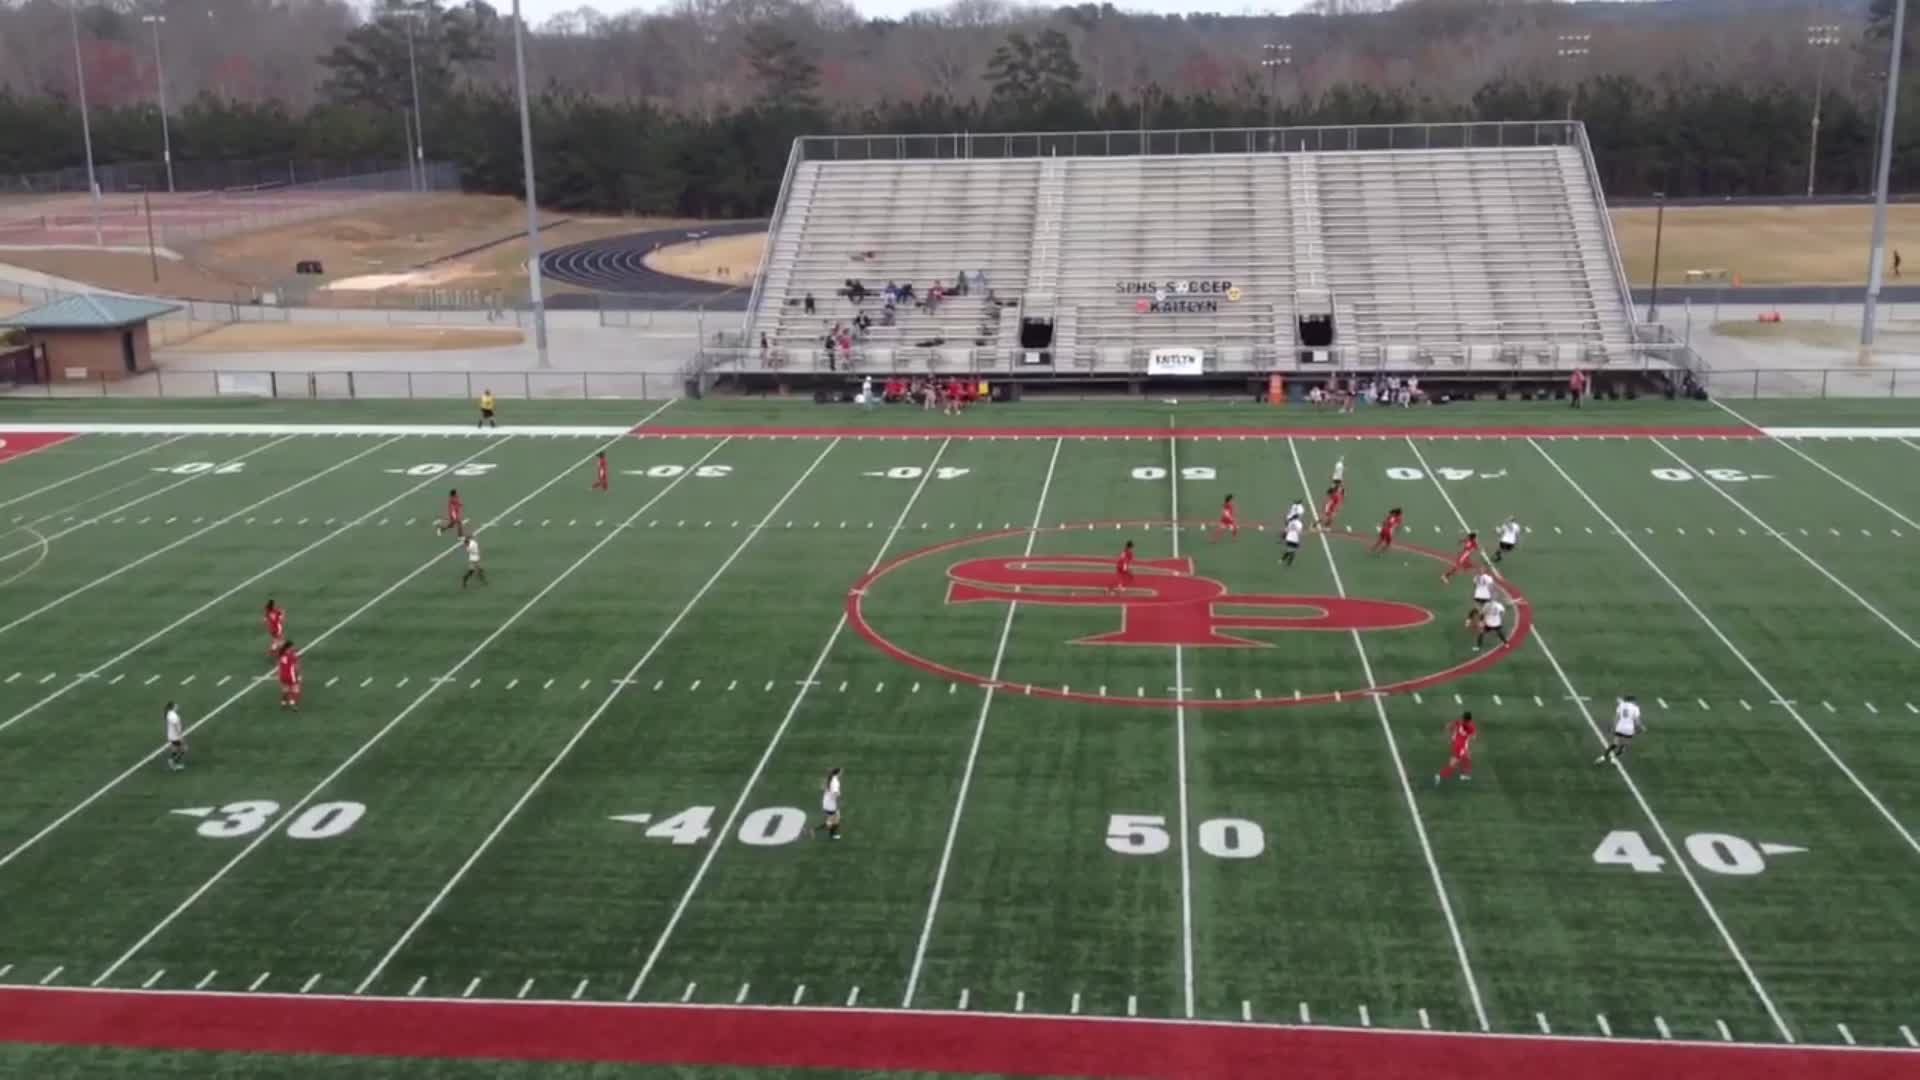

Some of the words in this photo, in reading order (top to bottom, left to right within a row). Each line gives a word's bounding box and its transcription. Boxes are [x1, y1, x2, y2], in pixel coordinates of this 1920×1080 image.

[1116, 281, 1157, 293] SPHS
[1150, 300, 1217, 312] KAITLYN
[196, 801, 366, 838] 30
[645, 806, 807, 845] 40
[1105, 814, 1264, 858] 50
[1593, 830, 1766, 874] 40
